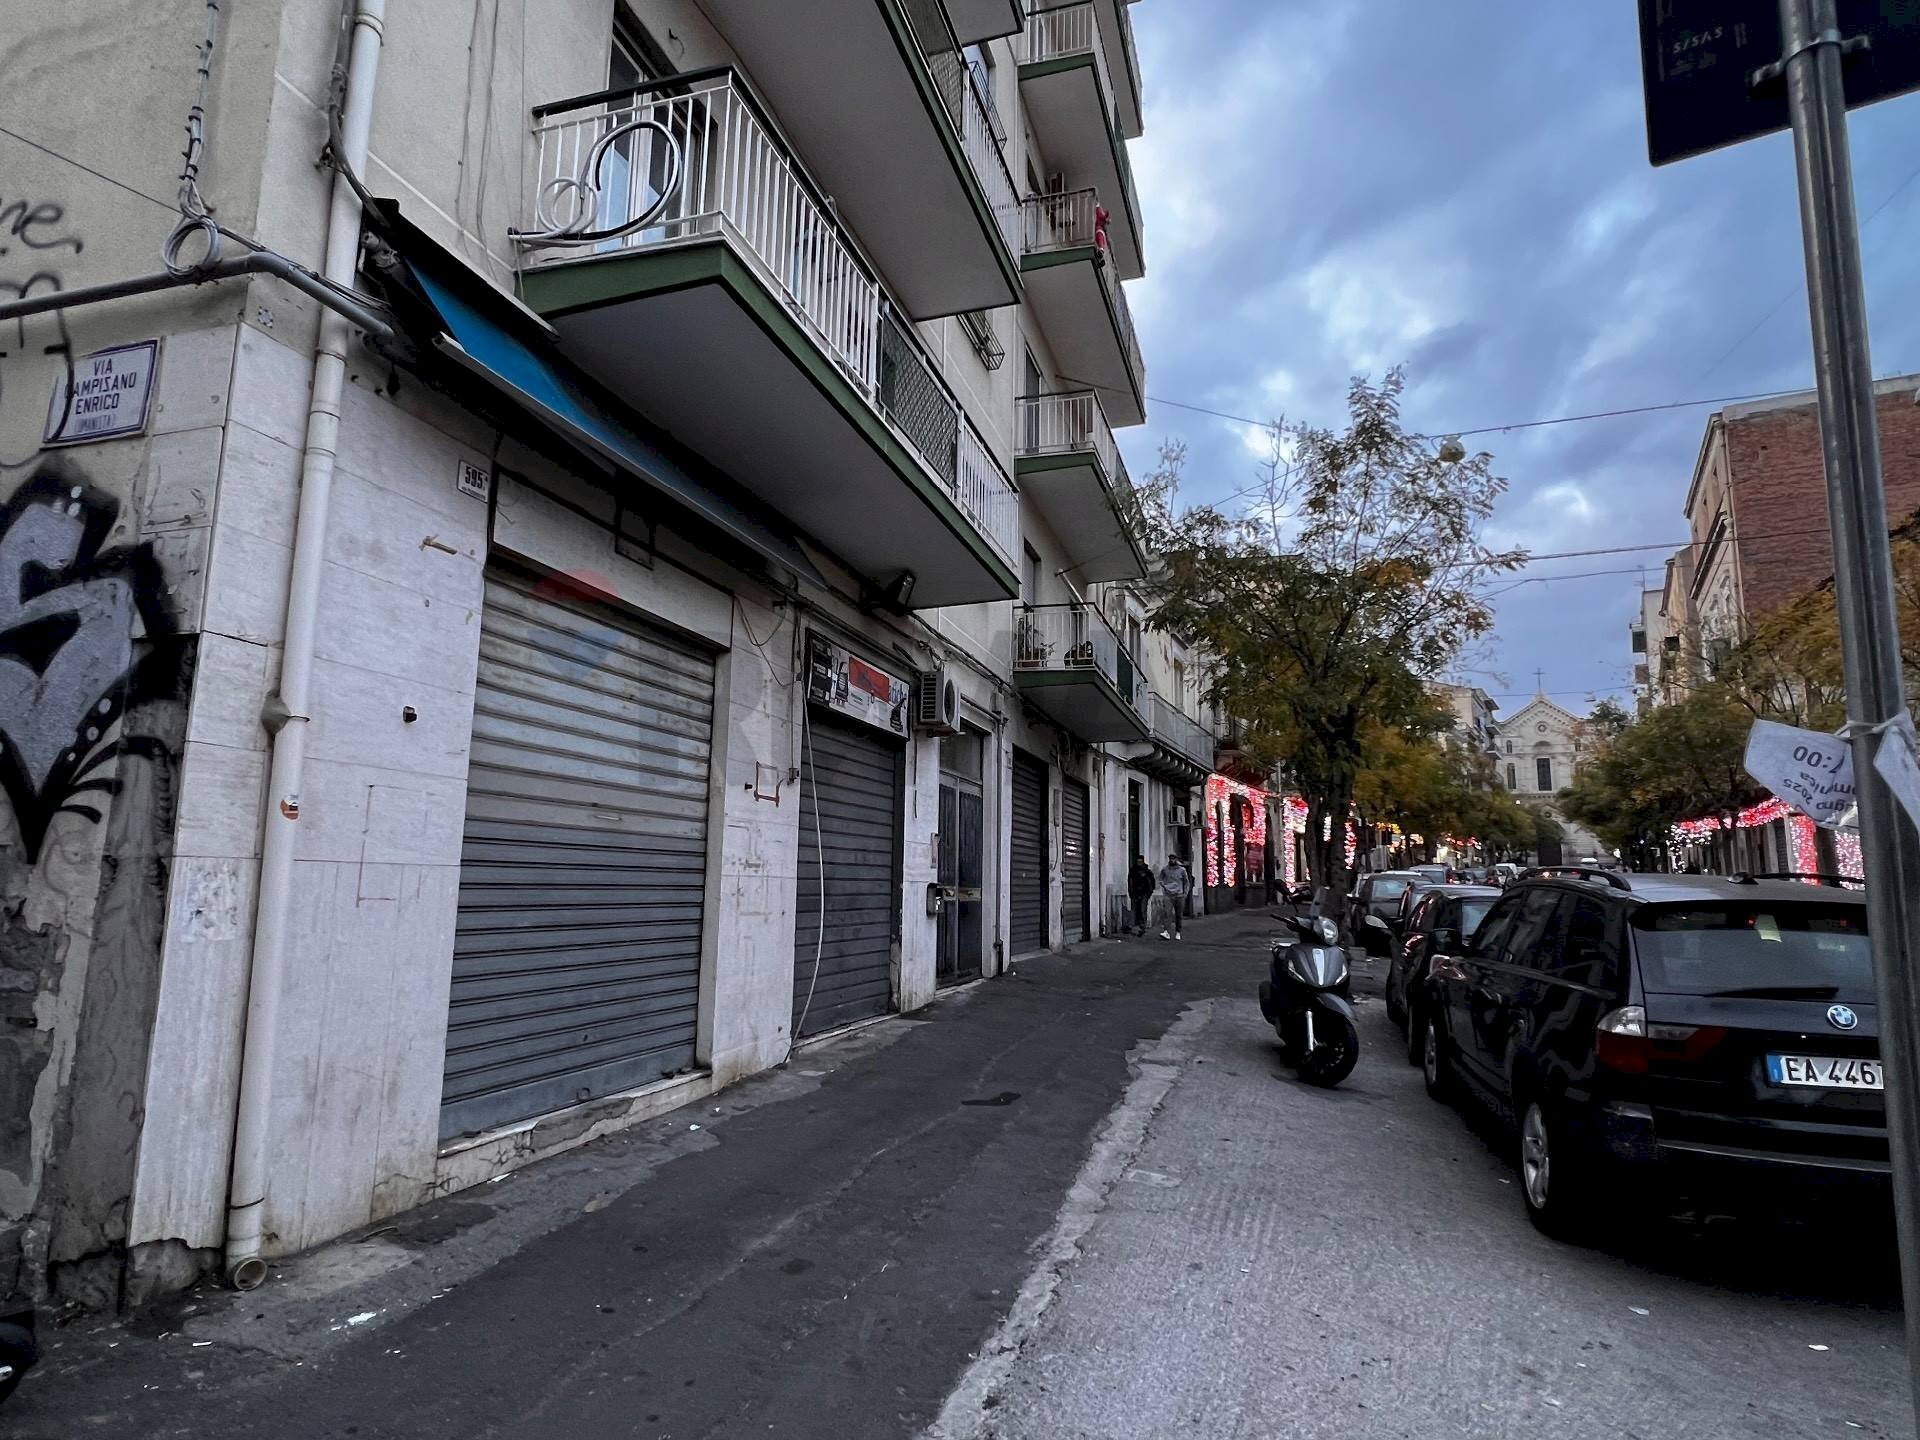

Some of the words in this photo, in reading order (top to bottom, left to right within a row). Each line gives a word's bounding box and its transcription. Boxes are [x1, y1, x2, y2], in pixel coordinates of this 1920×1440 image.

[94, 359, 113, 375] VIA
[76, 393, 120, 415] ENRICO
[465, 466, 483, 489] 595
[1783, 778, 1813, 805] 2025
[1785, 1058, 1819, 1083] EA
[1828, 1060, 1883, 1085] 446
